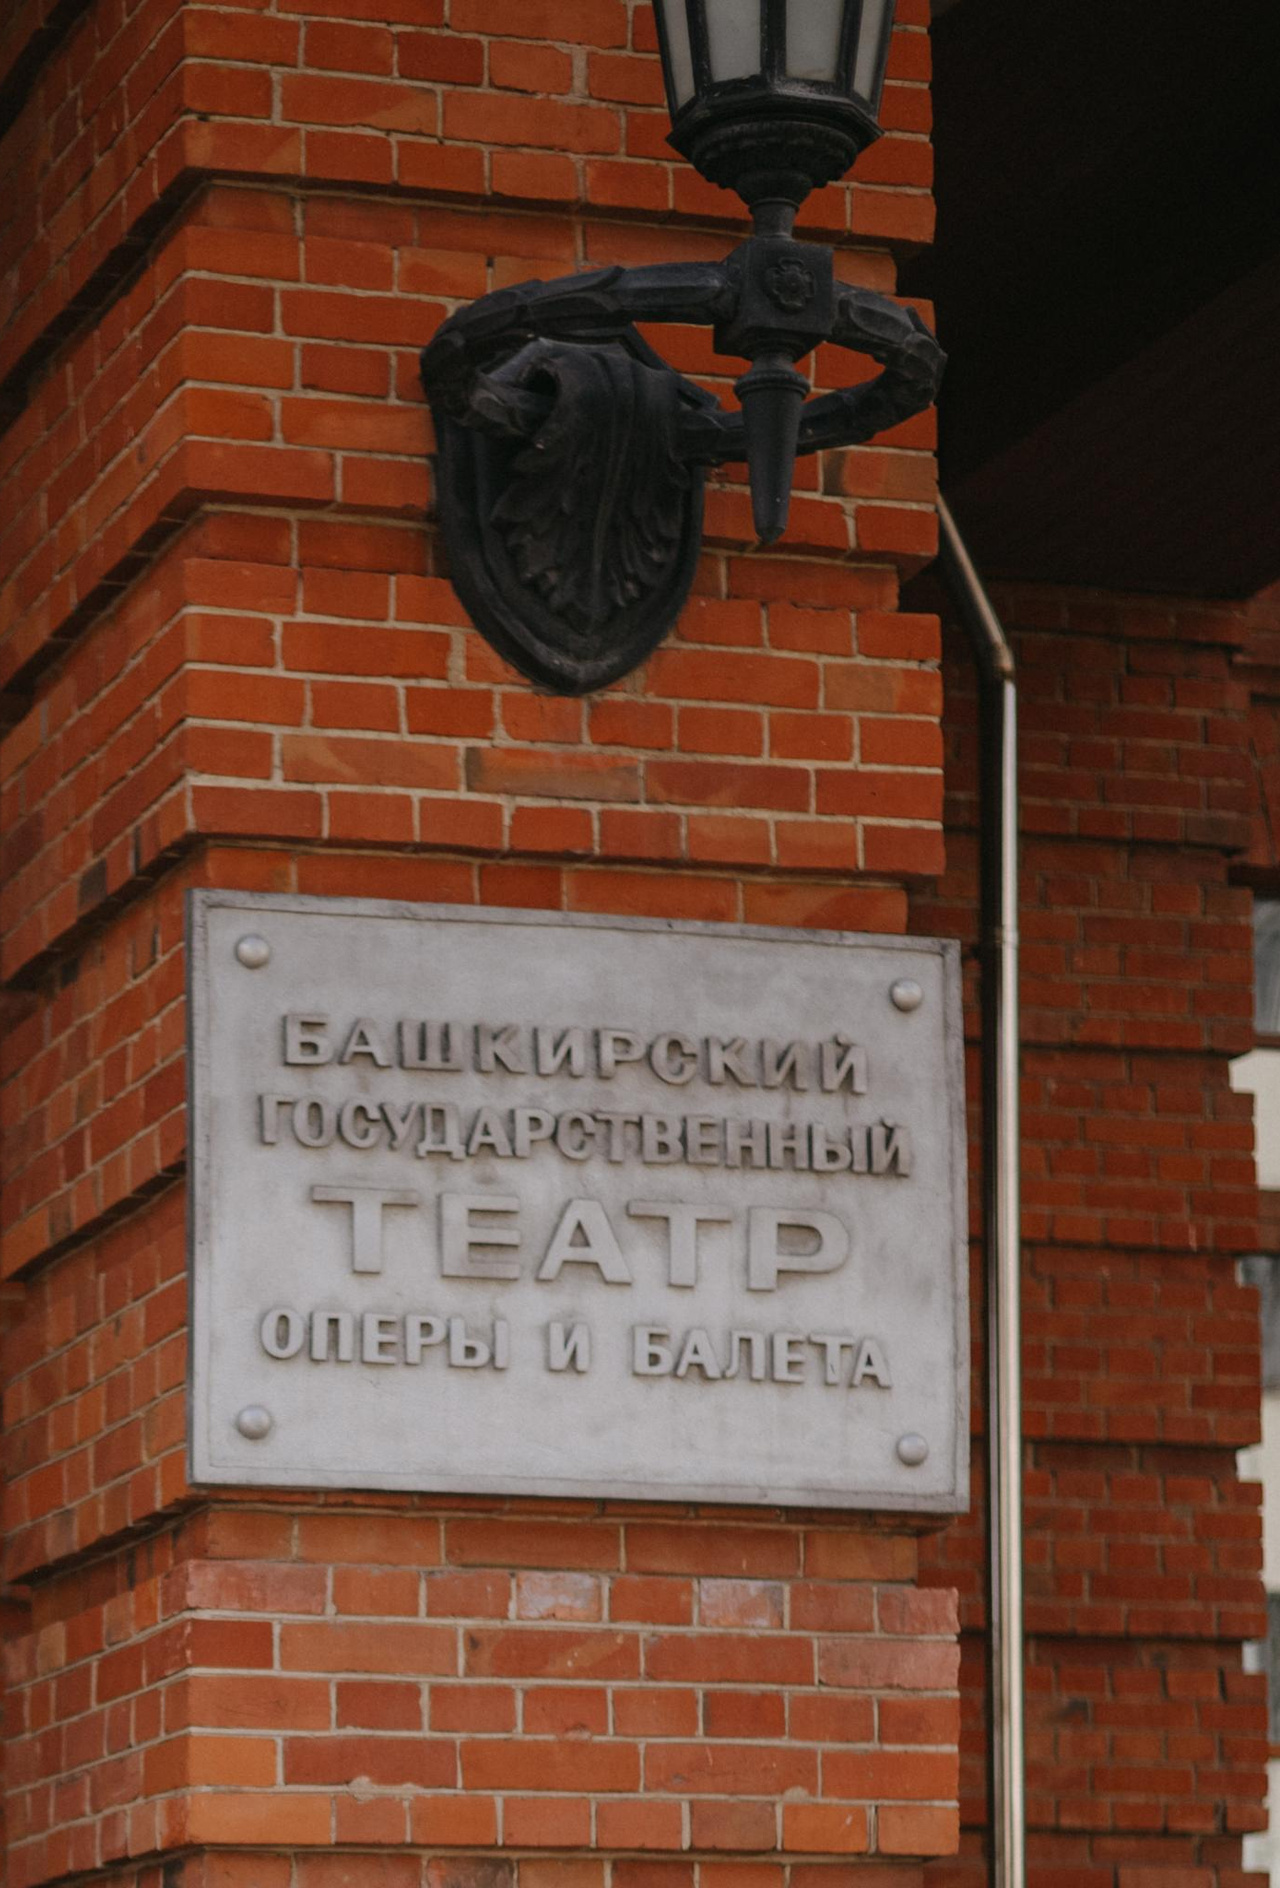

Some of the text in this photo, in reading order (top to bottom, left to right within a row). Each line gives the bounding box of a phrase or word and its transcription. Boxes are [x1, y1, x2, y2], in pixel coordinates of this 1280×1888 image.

[282, 1013, 868, 1095] БАШКИРСКИЙ
[257, 1094, 911, 1177] ГОСУДАРСТВЕННЫЙ
[310, 1184, 850, 1291] ТЕАТР
[260, 1308, 893, 1389] ОПЕРЫ И БАЛЕТА
